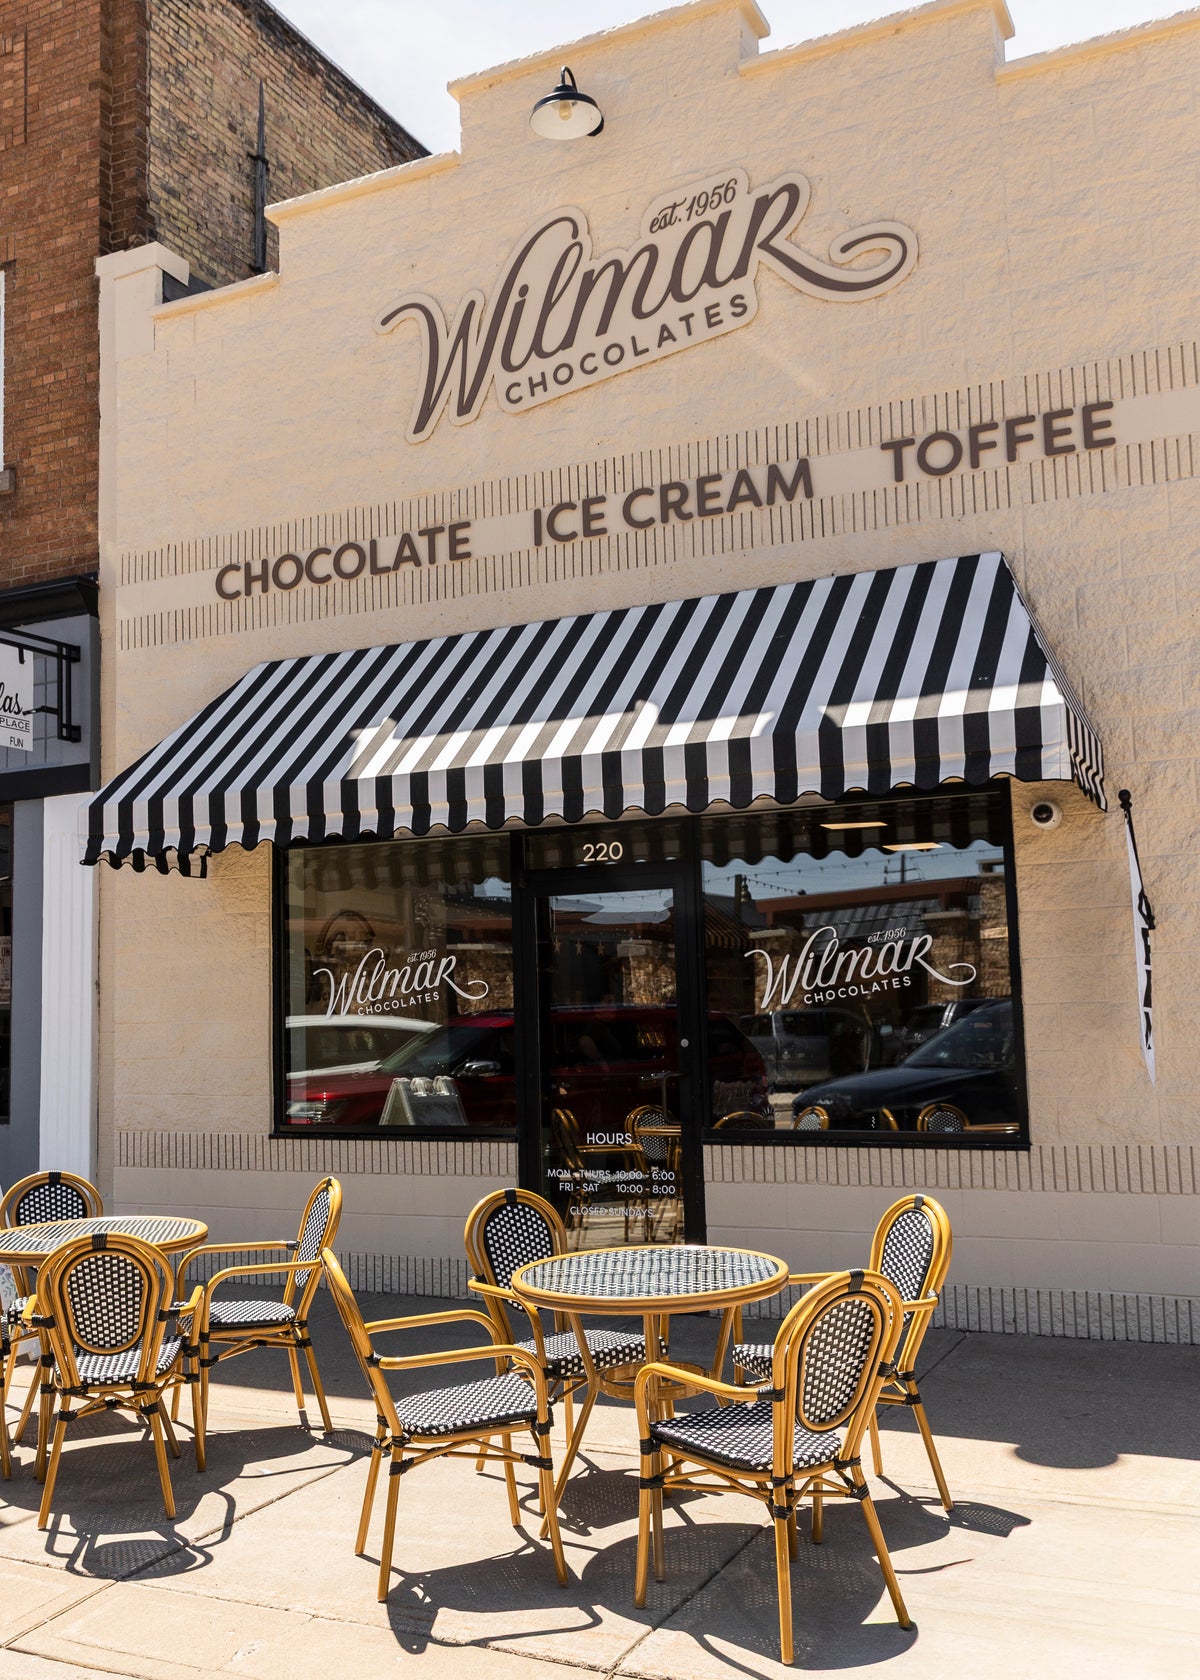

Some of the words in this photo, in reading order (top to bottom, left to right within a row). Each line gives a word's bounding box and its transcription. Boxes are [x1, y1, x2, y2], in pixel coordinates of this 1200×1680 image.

[505, 294, 749, 405] CHOCOLATES
[215, 521, 472, 600] CHOCOLATE
[533, 495, 609, 547] ICE
[622, 457, 814, 530] CREAM
[880, 400, 1116, 483] TOFFEE
[9, 736, 24, 748] FUN
[583, 841, 623, 862] 220
[803, 976, 911, 1005] CHOCOLATES
[357, 991, 440, 1016] CHOCOLATES
[586, 1132, 633, 1145] HOURS
[547, 1168, 571, 1178] MON
[579, 1169, 611, 1179] THURS
[616, 1170, 643, 1180] 10:00
[651, 1170, 675, 1181] 6:00
[559, 1182, 574, 1192] FRI
[582, 1182, 600, 1192] SAT
[616, 1184, 643, 1193] 10:00
[652, 1184, 676, 1195] 8:00
[569, 1206, 607, 1216] CLOSED
[608, 1206, 655, 1218] SUNDAYS
